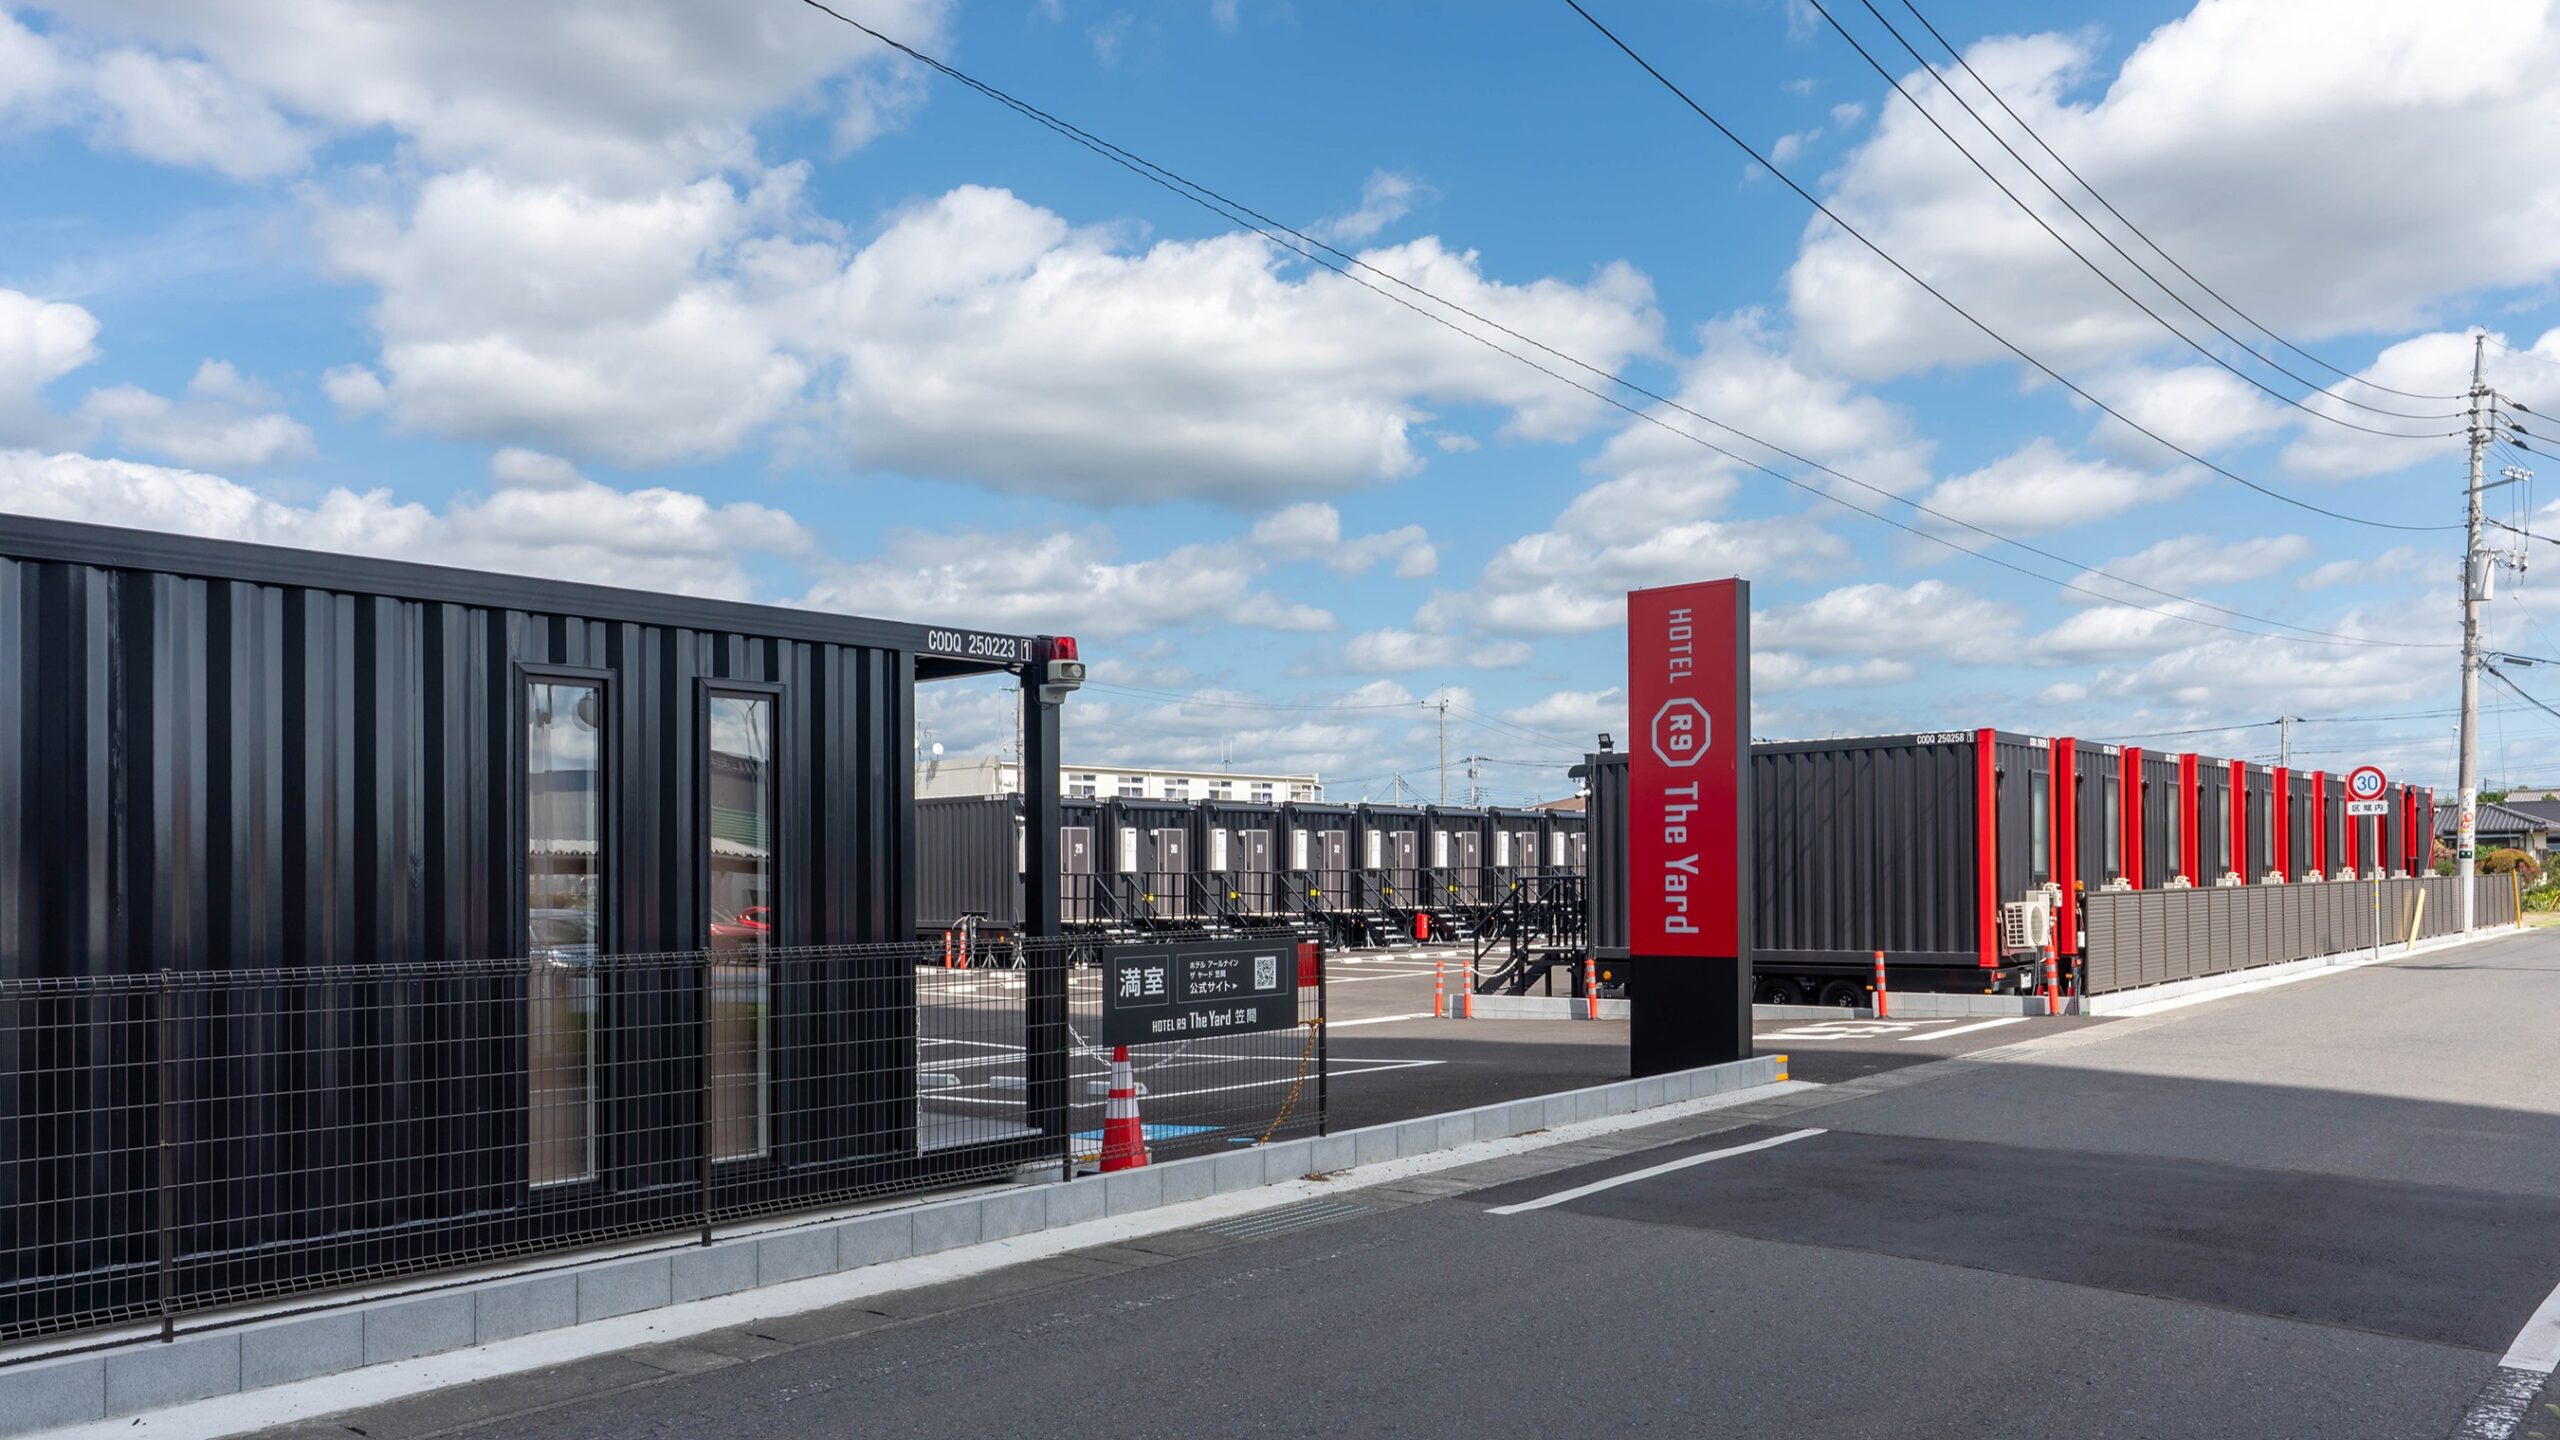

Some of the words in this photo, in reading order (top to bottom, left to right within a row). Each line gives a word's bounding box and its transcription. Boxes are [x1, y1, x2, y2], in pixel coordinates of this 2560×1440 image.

[928, 630, 962, 653] CODQ
[968, 634, 1016, 659] 250223
[1022, 640, 1031, 661] 1
[1669, 608, 1693, 684] HOTEL
[1669, 714, 1693, 751] R9
[2357, 775, 2378, 791] 30
[1664, 781, 1699, 843] The
[1664, 853, 1699, 933] Yard
[1190, 960, 1206, 970] ホテル
[1208, 959, 1239, 968] アールナイン
[1119, 966, 1165, 998] 満室
[1190, 980, 1231, 994] 公式サイト
[1152, 1018, 1175, 1033] HOTEL
[1177, 1017, 1187, 1030] R9
[1190, 1011, 1207, 1029] The
[1209, 1008, 1232, 1027] Yard
[1234, 1007, 1257, 1025] 笠間
